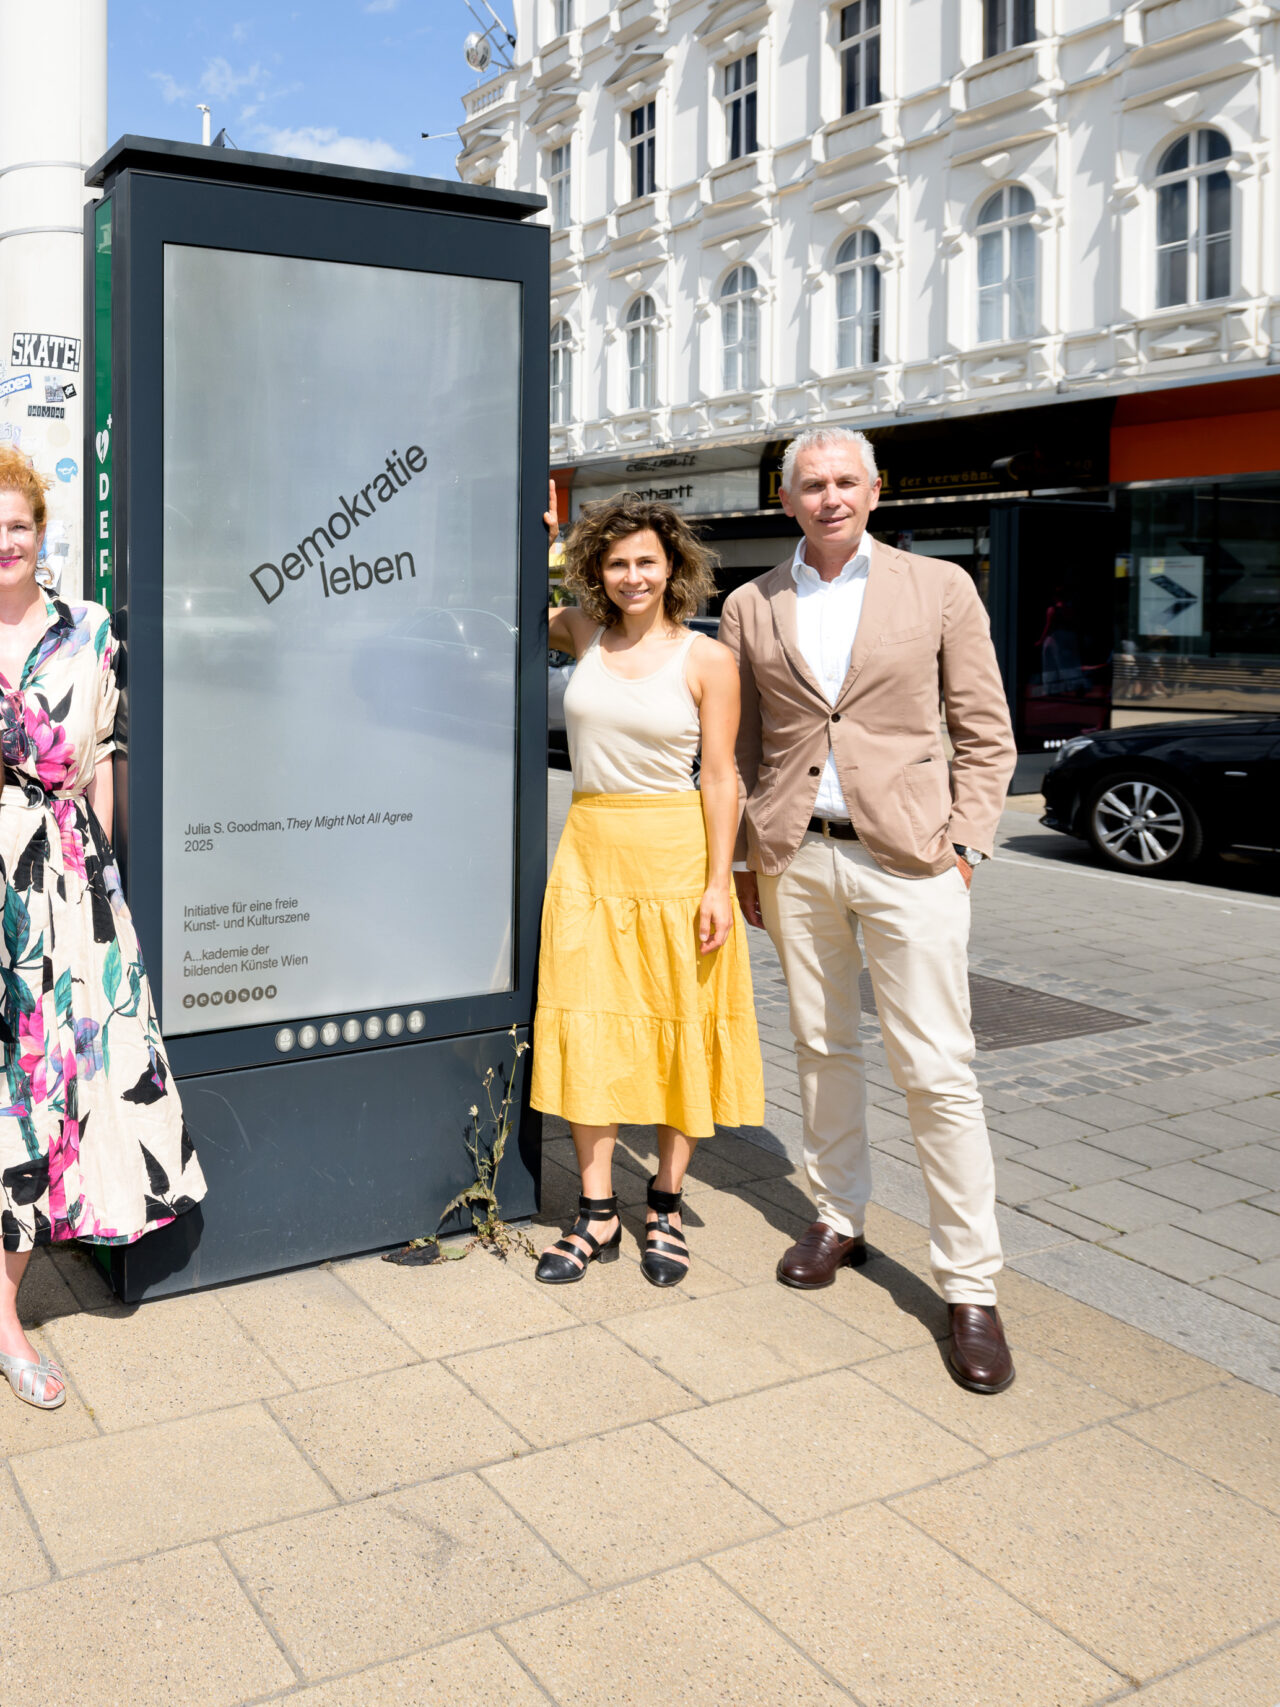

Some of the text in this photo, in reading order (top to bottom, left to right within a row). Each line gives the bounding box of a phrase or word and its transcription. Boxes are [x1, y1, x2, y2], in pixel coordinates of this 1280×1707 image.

[12, 333, 80, 371] SKATE!
[249, 445, 428, 605] Demokratie
[320, 551, 417, 598] leben
[184, 811, 413, 836] Julia S. Goodman, They Might Not All Agree
[184, 840, 214, 852] 2025
[184, 897, 299, 917] Initiative für eine freie
[184, 912, 310, 932] Kunst- und Kulturszene
[183, 944, 270, 962] A...kademie der
[184, 954, 309, 977] bildenden Künste Wien
[183, 985, 277, 1009] gewista
[275, 1010, 426, 1052] gewista
